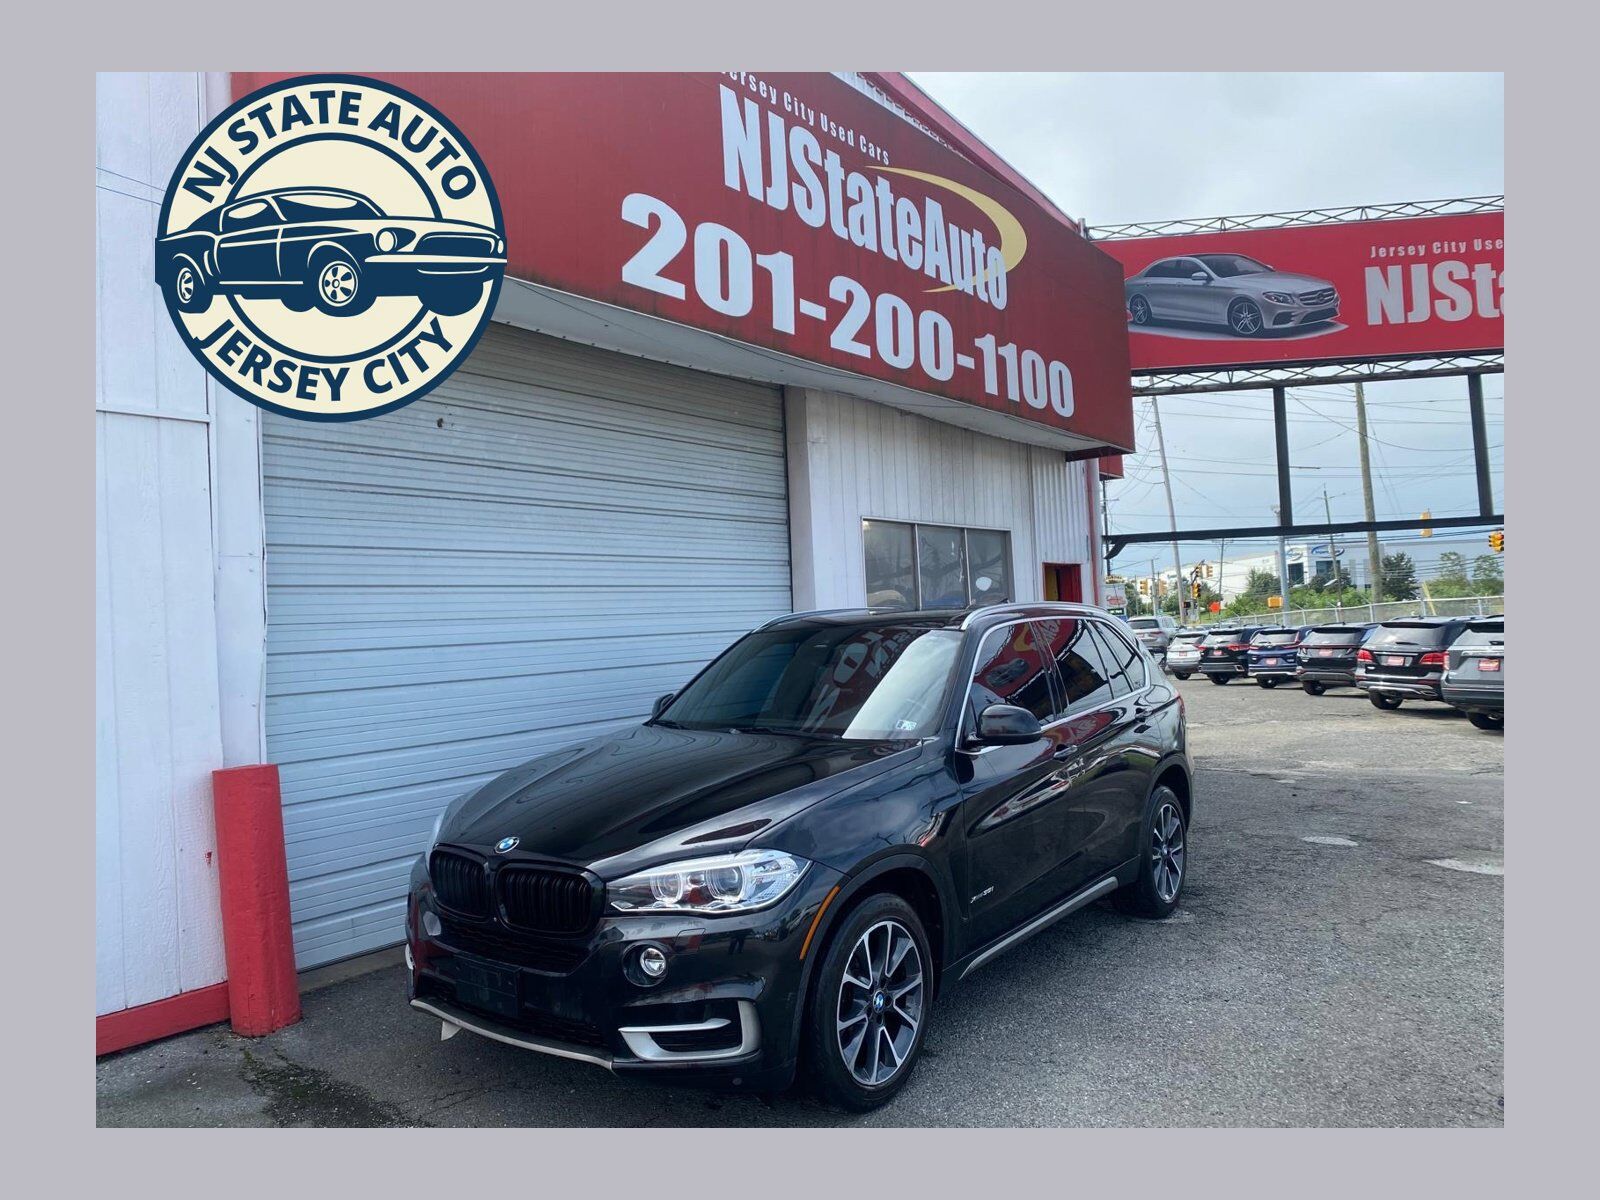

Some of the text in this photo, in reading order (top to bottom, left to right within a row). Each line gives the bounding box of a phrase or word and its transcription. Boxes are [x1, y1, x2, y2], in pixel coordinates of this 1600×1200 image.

[721, 72, 890, 166] ersey City Used Cars
[719, 83, 1008, 311] NJStateAuto
[1364, 260, 1504, 326] NJSt
[1370, 244, 1426, 258] Jersey
[1432, 241, 1467, 254] City
[620, 192, 1075, 418] 201-200-1100
